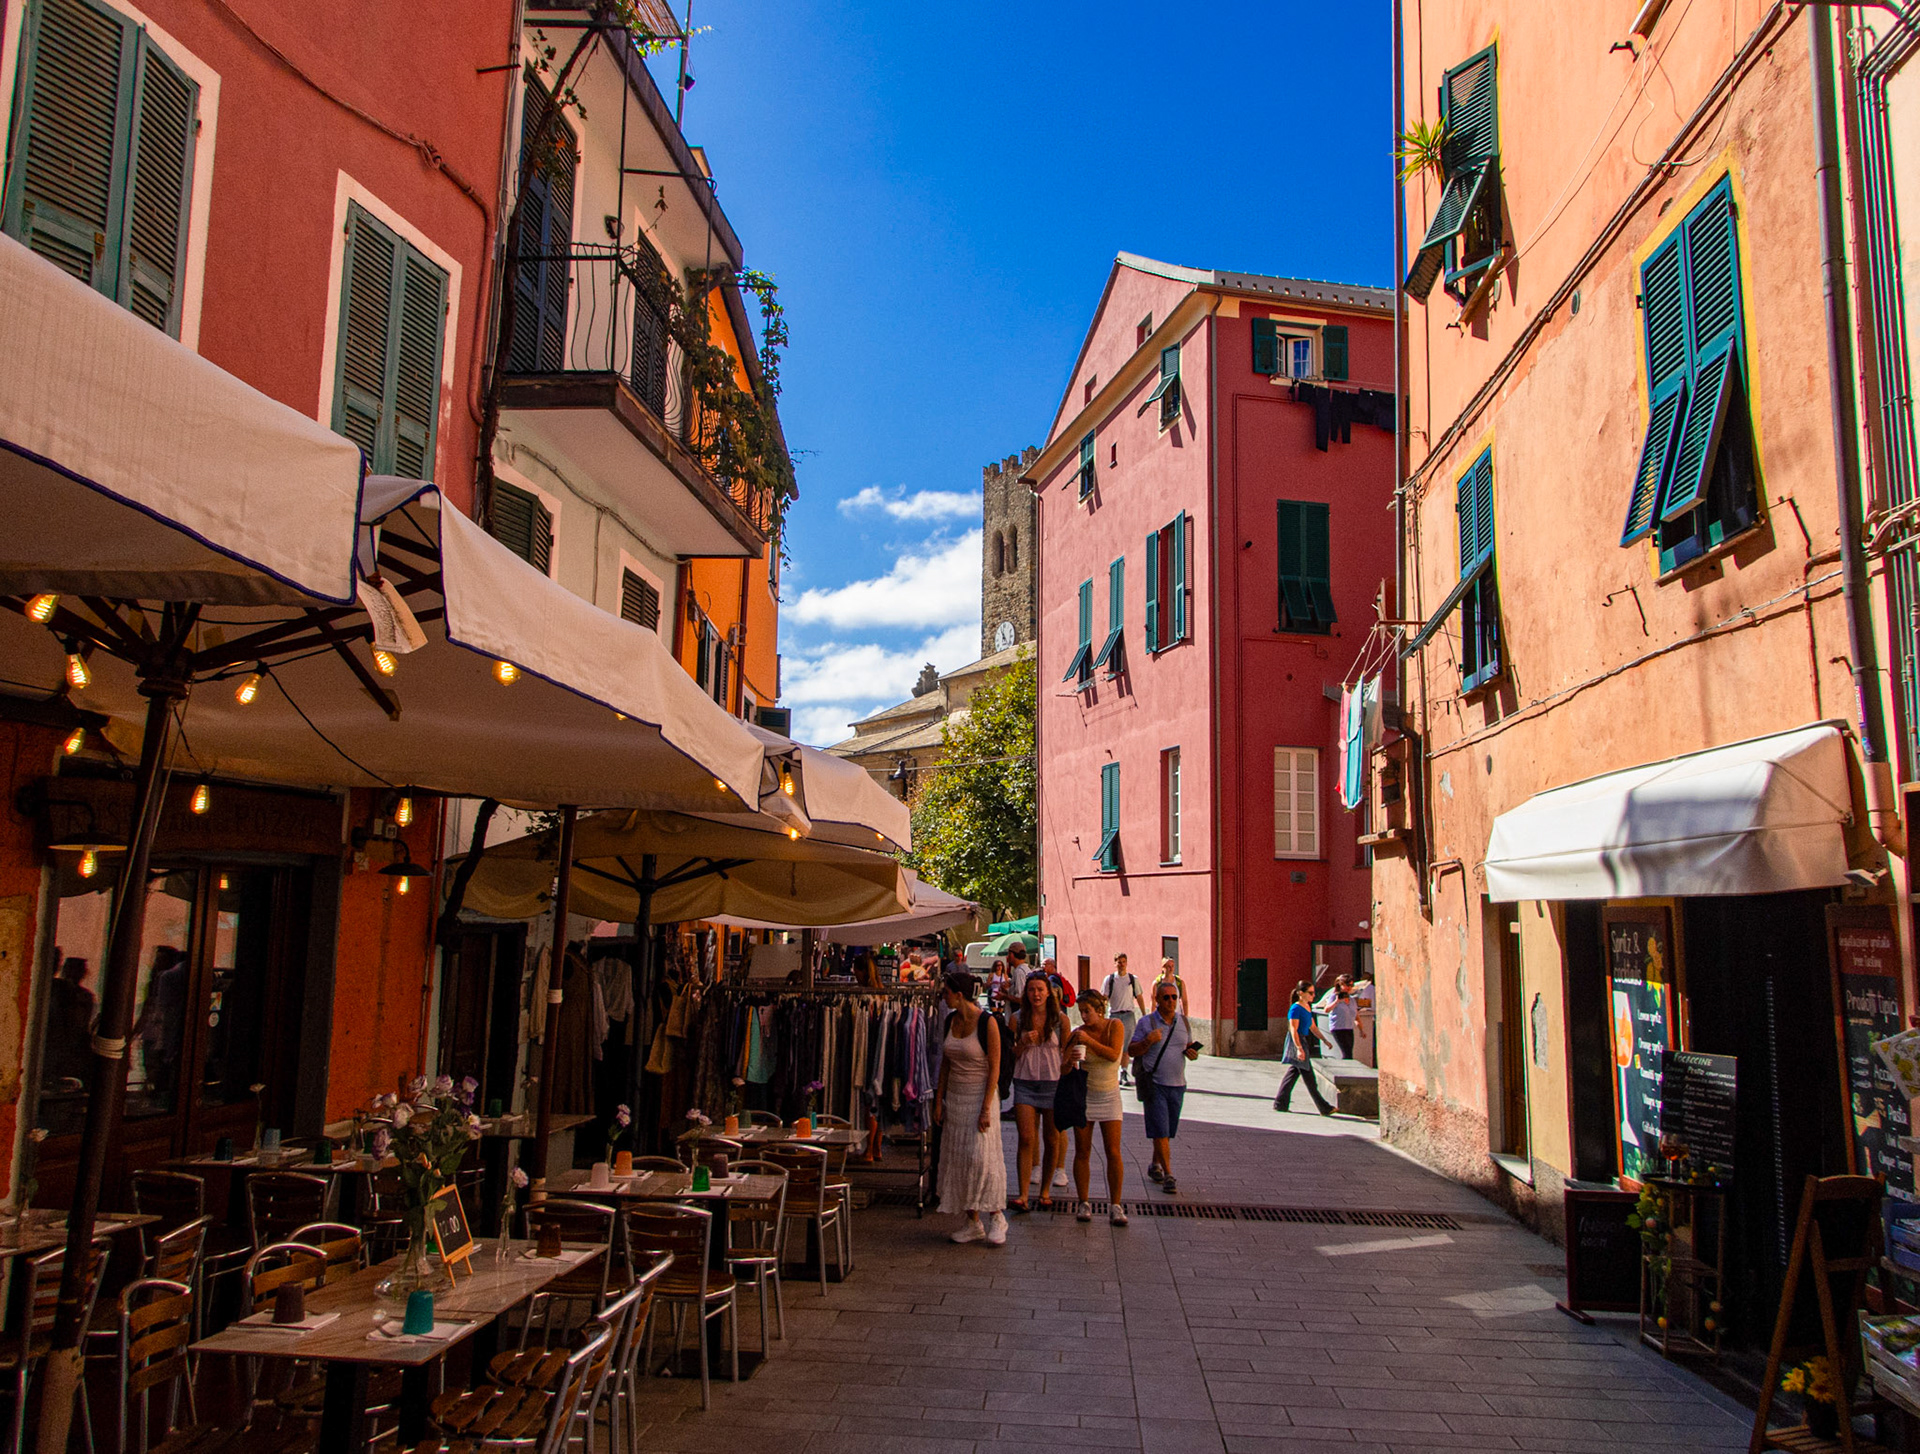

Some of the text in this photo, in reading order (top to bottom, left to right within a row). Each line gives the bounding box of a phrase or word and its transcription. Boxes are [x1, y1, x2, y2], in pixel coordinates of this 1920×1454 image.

[1611, 928, 1641, 961] Spritz &
[1613, 958, 1643, 986] cocktails
